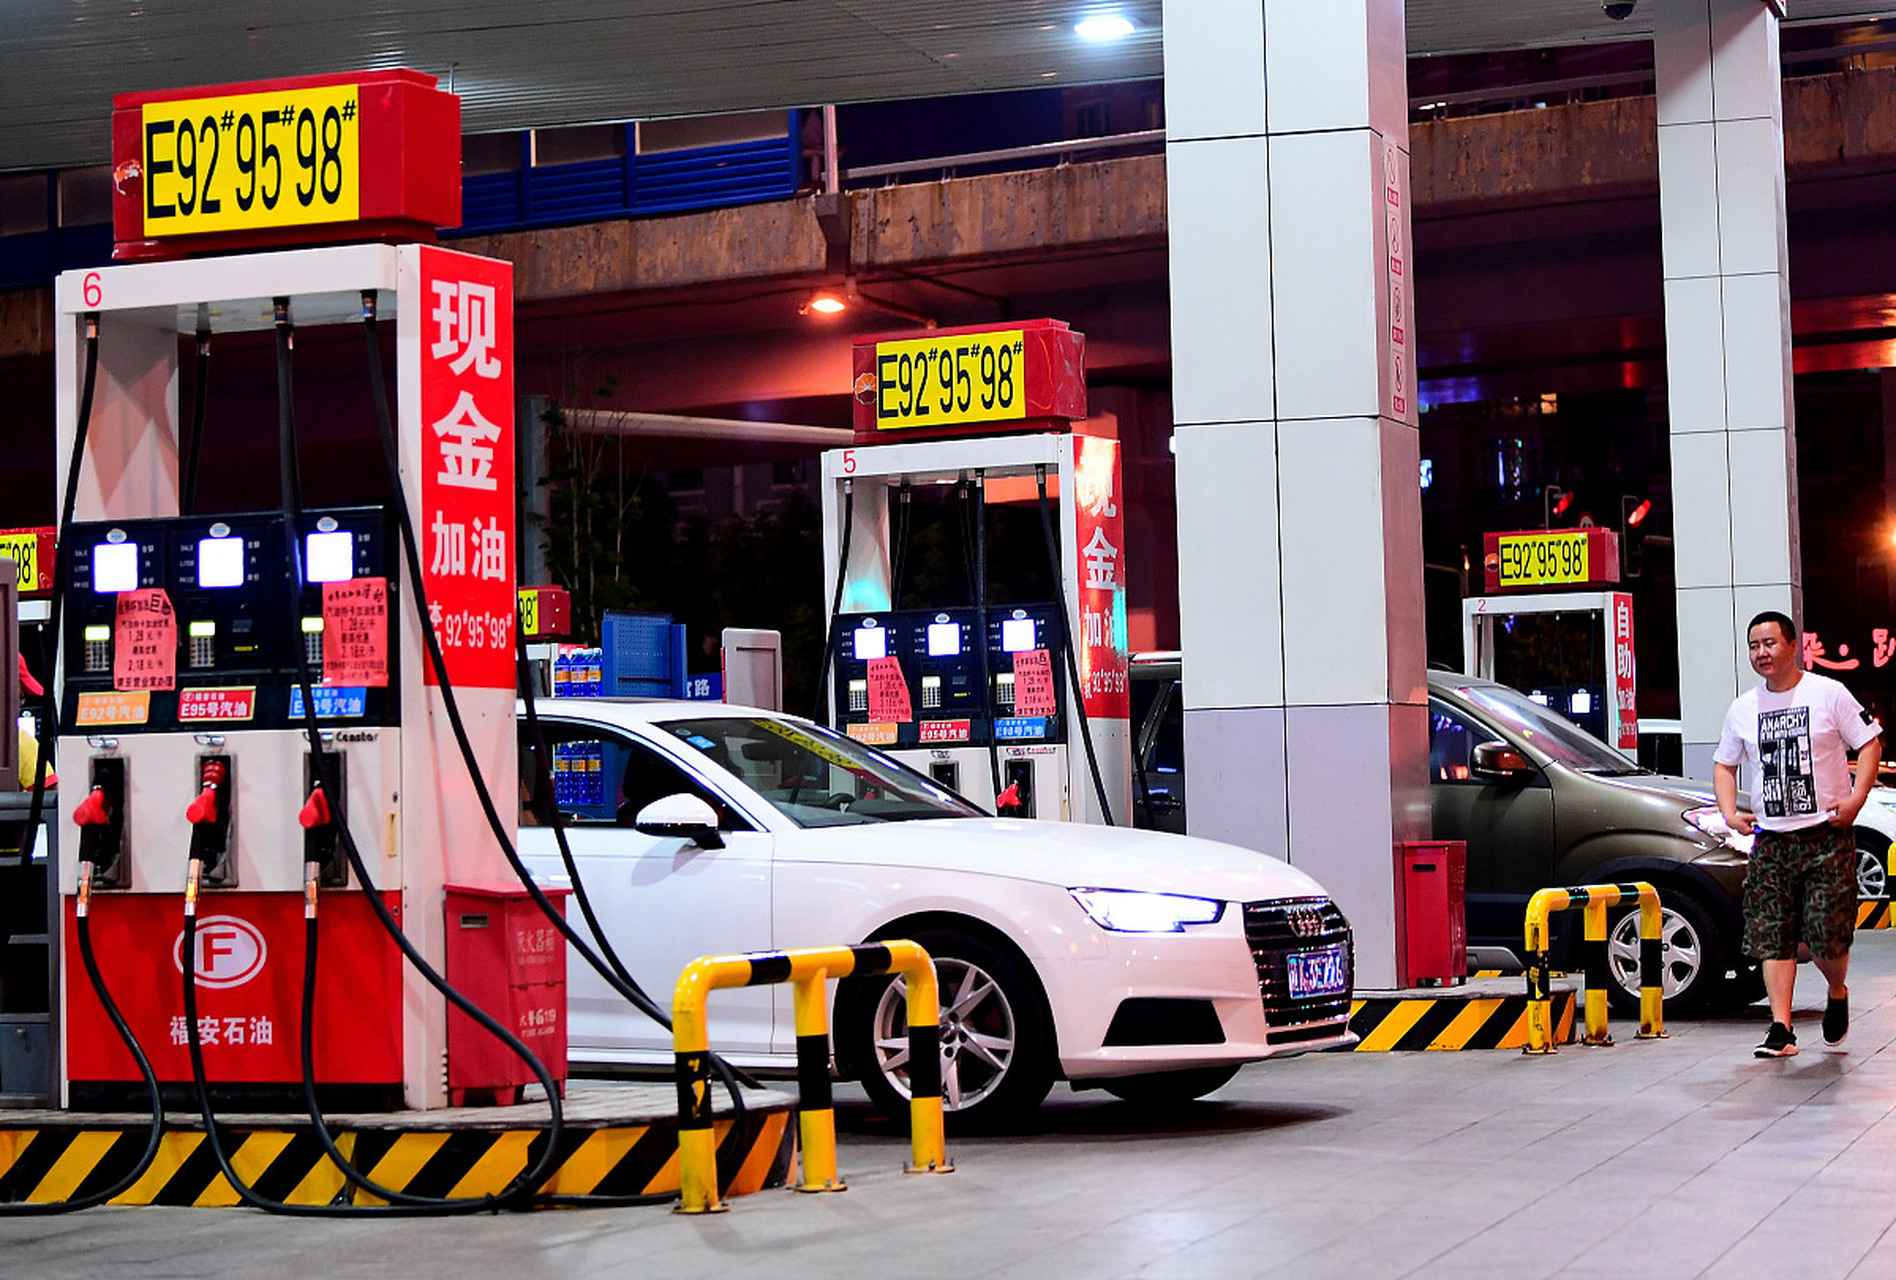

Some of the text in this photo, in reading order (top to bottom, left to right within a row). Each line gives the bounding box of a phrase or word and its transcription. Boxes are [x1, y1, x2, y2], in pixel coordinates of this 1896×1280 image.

[82, 272, 102, 307] 6
[843, 449, 857, 474] 5
[430, 510, 506, 582] 加油
[1478, 598, 1486, 612] 2
[1617, 601, 1632, 679] 自助
[181, 700, 248, 718] E95号汽油
[1761, 712, 1806, 732] ANARCHY
[202, 931, 237, 972] F
[169, 1015, 273, 1045] 福安石油
